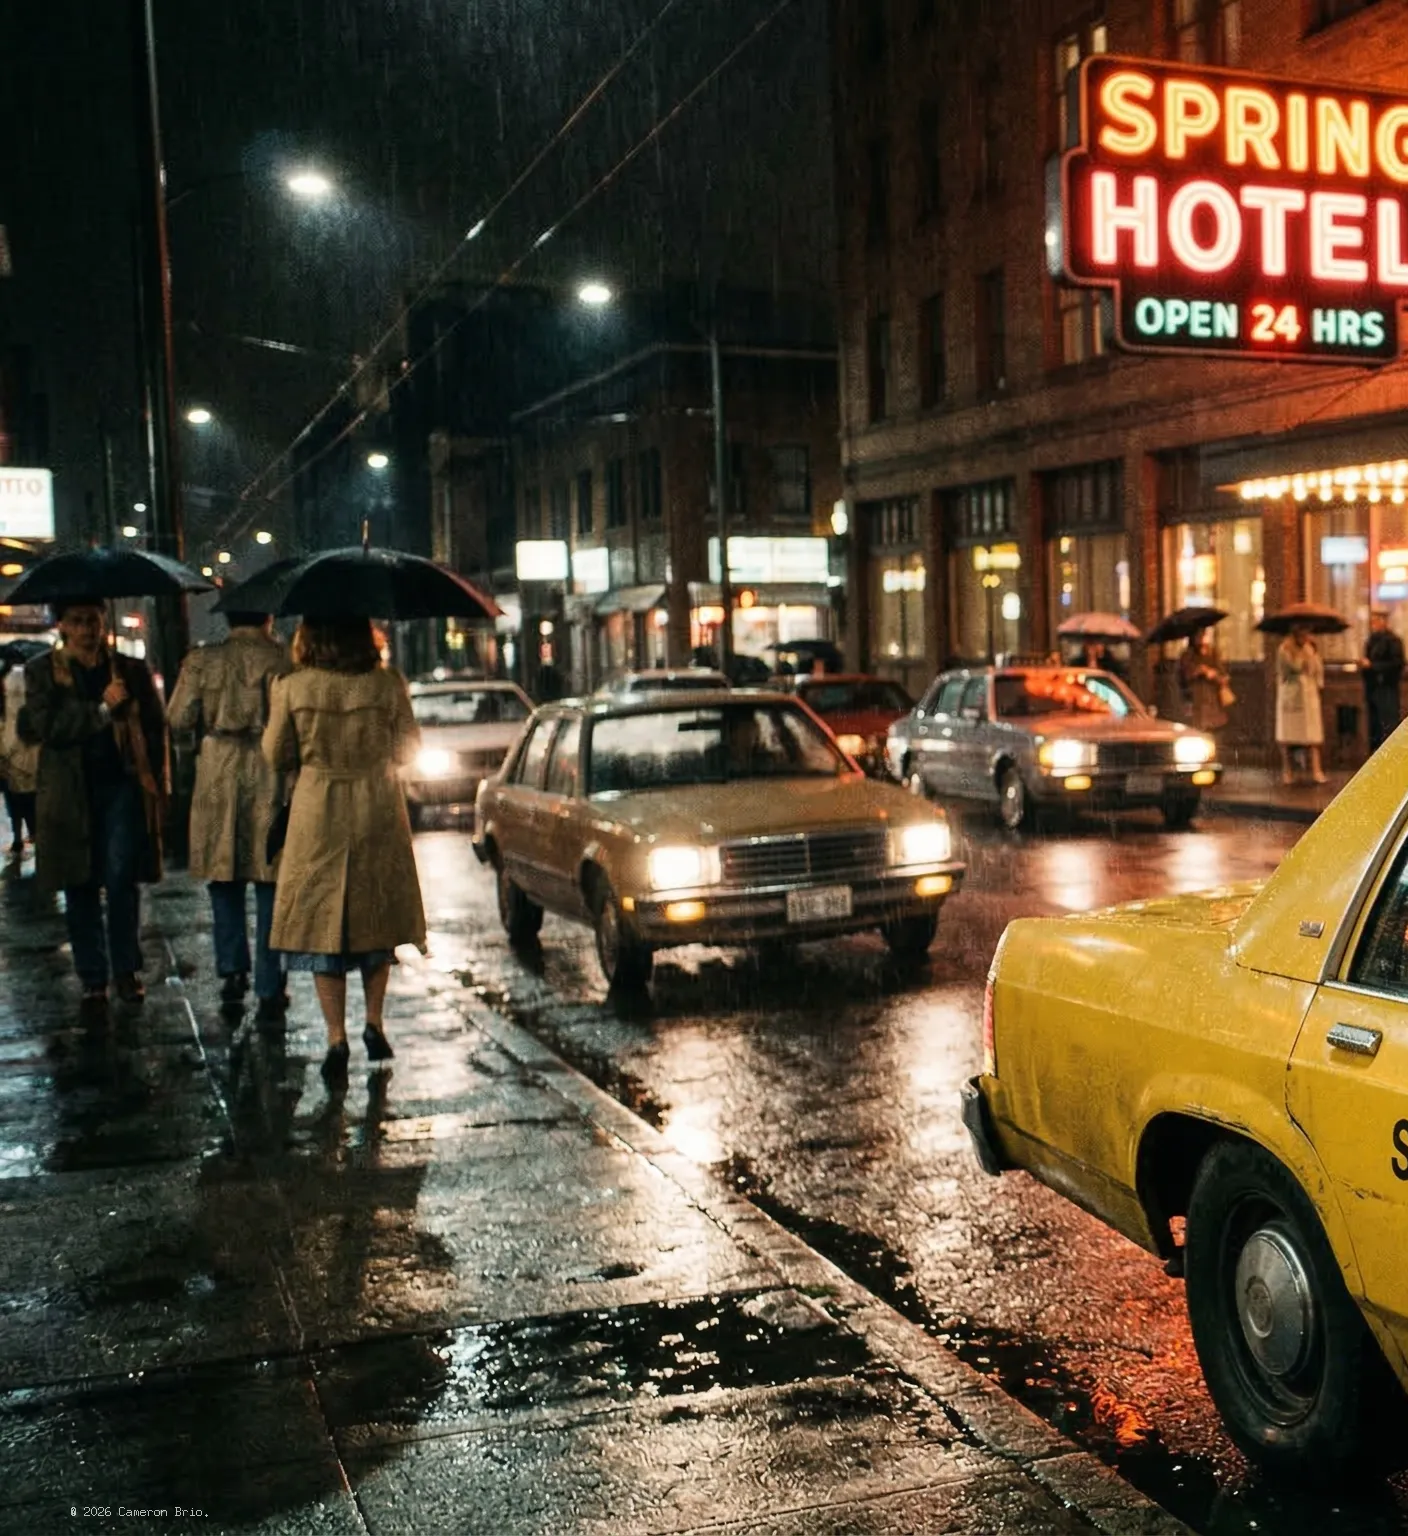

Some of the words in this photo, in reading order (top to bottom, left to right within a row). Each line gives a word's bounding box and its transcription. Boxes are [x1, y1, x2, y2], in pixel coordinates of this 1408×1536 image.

[1135, 298, 1238, 338] OPEN
[1250, 304, 1301, 343] 24
[1312, 308, 1386, 347] HRS
